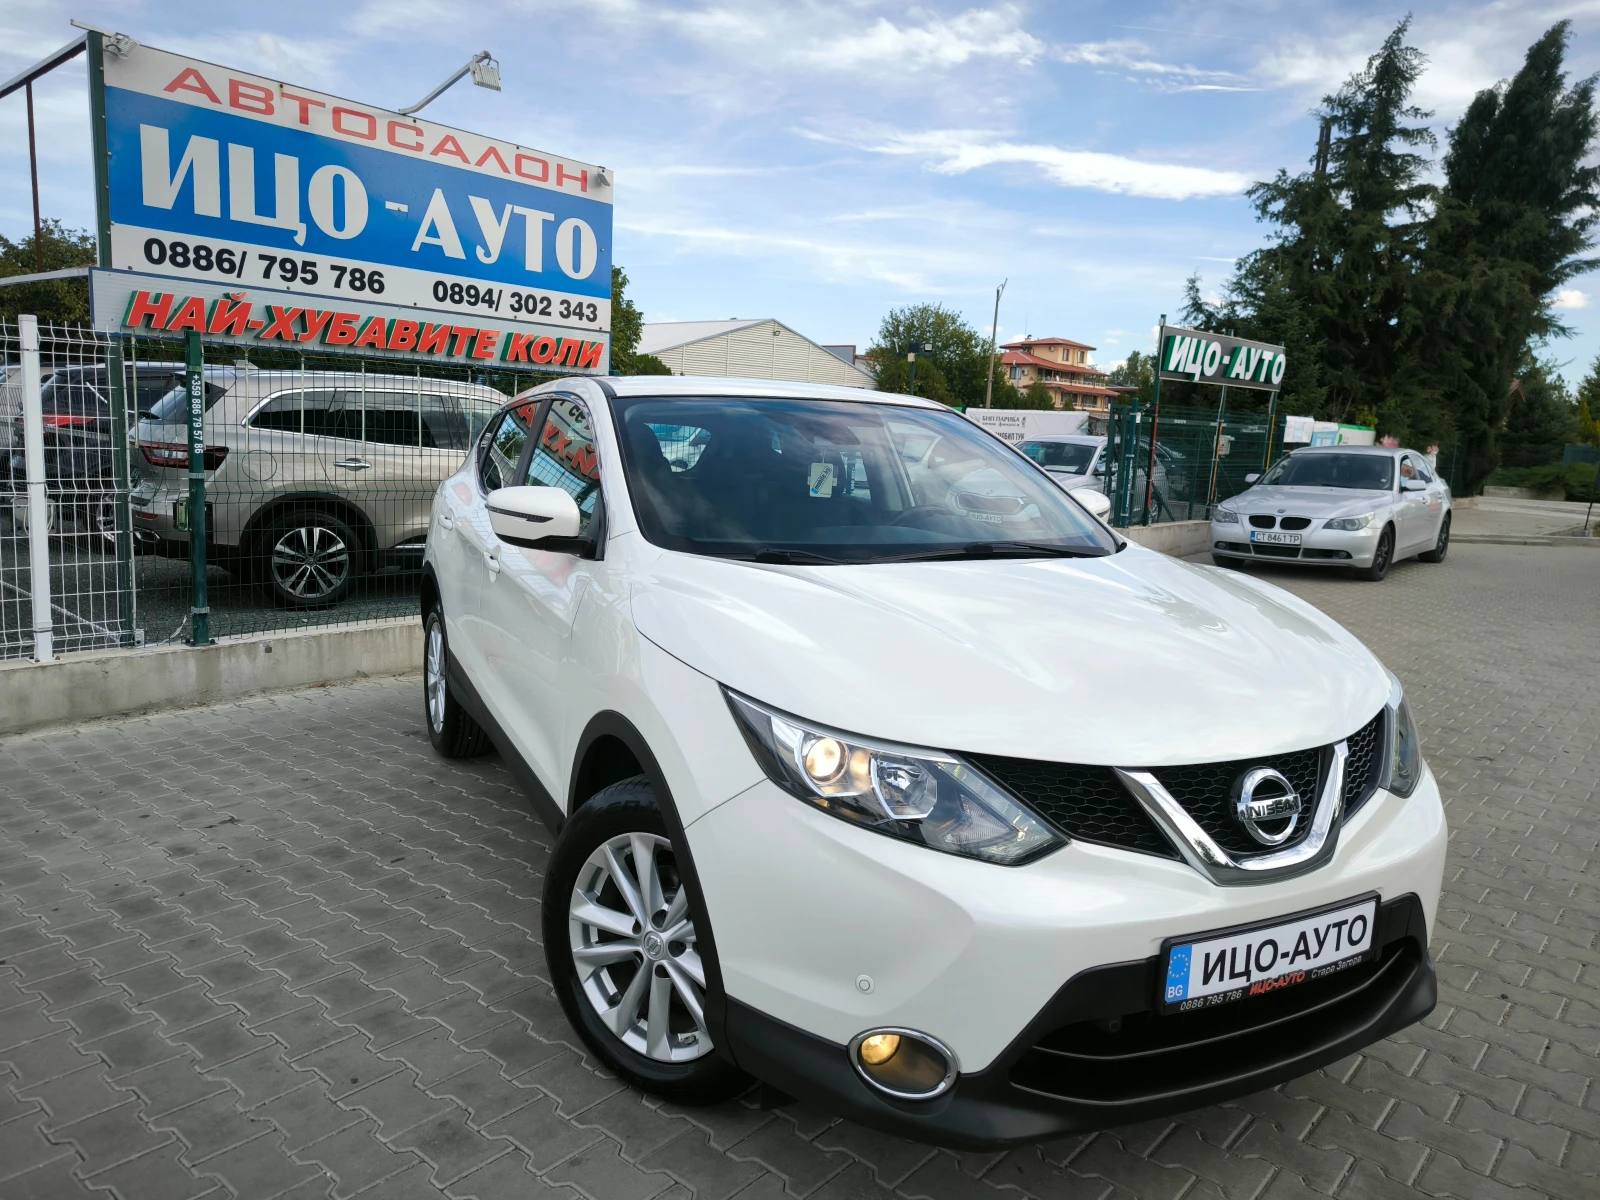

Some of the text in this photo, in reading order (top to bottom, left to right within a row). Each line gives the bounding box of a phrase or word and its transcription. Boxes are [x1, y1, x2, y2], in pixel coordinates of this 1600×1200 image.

[163, 67, 588, 192] АВТОСАЛОН
[143, 237, 385, 295] 0886/ 795 786
[432, 279, 598, 323] 0894/ 302 343
[124, 290, 605, 369] НАЙ-ХУБАВИТЕ КОЛИ
[1166, 335, 1287, 385] ИЦО-АУТО
[191, 374, 204, 454] +359 886 79 57 86
[1249, 795, 1300, 818] NISSAN
[1202, 914, 1368, 987] ИЦО-АУТО
[1167, 985, 1183, 999] BG
[1180, 996, 1204, 1011] 0886
[1206, 993, 1224, 1006] 795
[1226, 989, 1242, 1002] 786
[1249, 971, 1306, 995] ИЦО-АУТО
[1311, 962, 1335, 979] Стара
